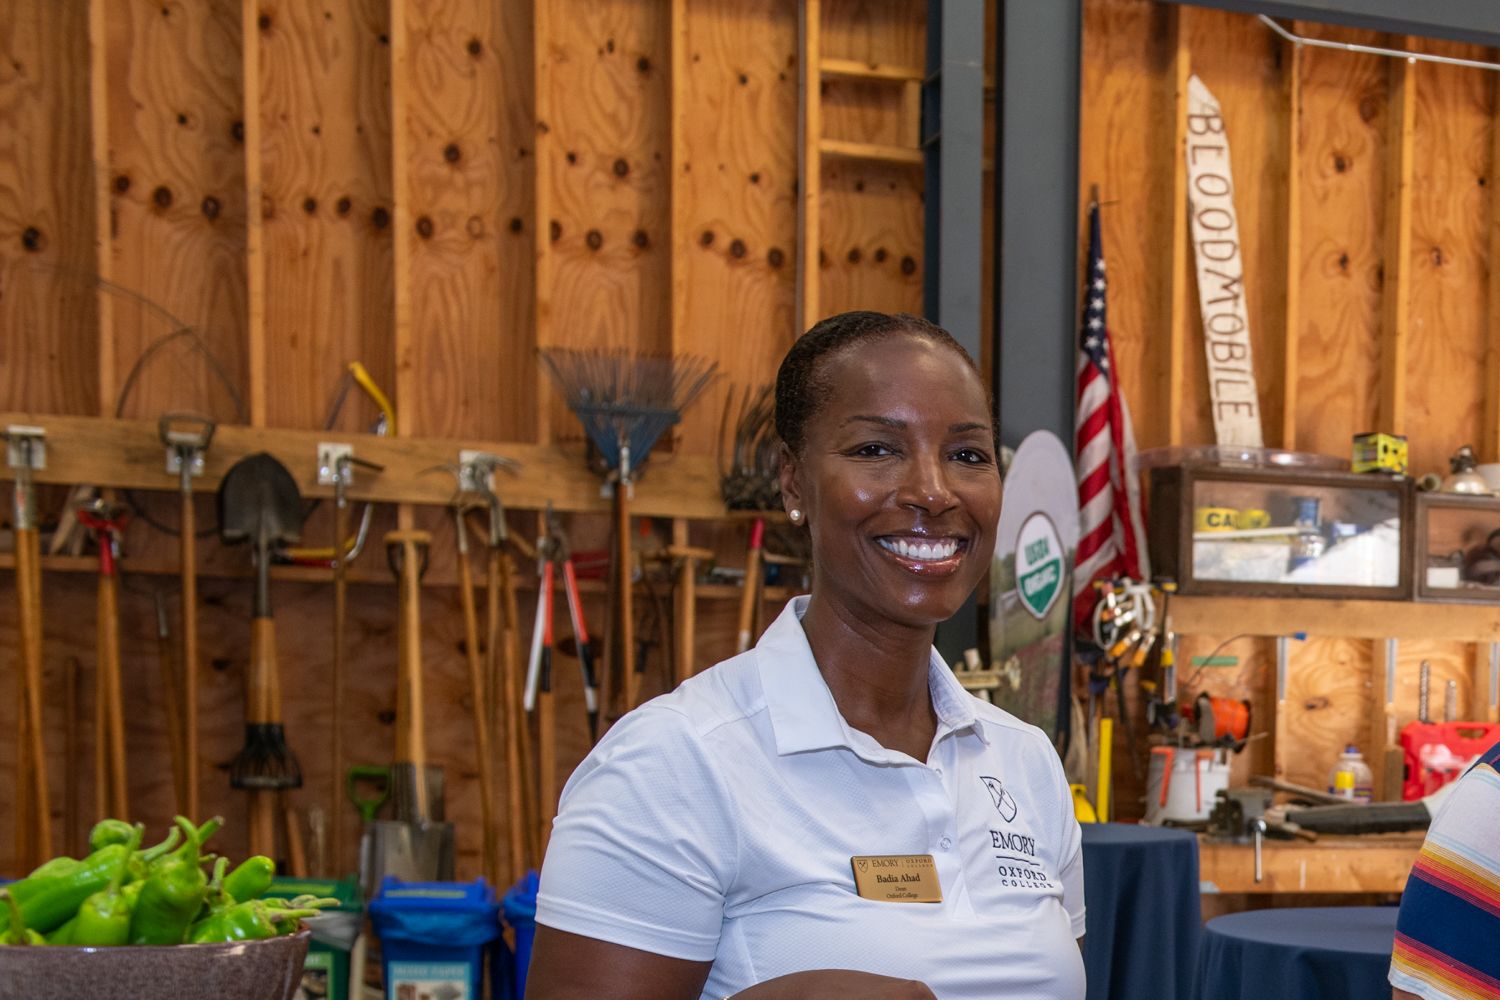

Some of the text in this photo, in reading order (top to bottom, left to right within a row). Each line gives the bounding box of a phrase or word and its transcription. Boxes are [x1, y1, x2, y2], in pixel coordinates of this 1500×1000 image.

[1187, 112, 1254, 420] BLOODMOBILE
[989, 830, 1035, 857] EMORY
[872, 859, 900, 868] EMORY
[877, 873, 921, 884] Badia Ahad
[998, 866, 1047, 881] OXFORD
